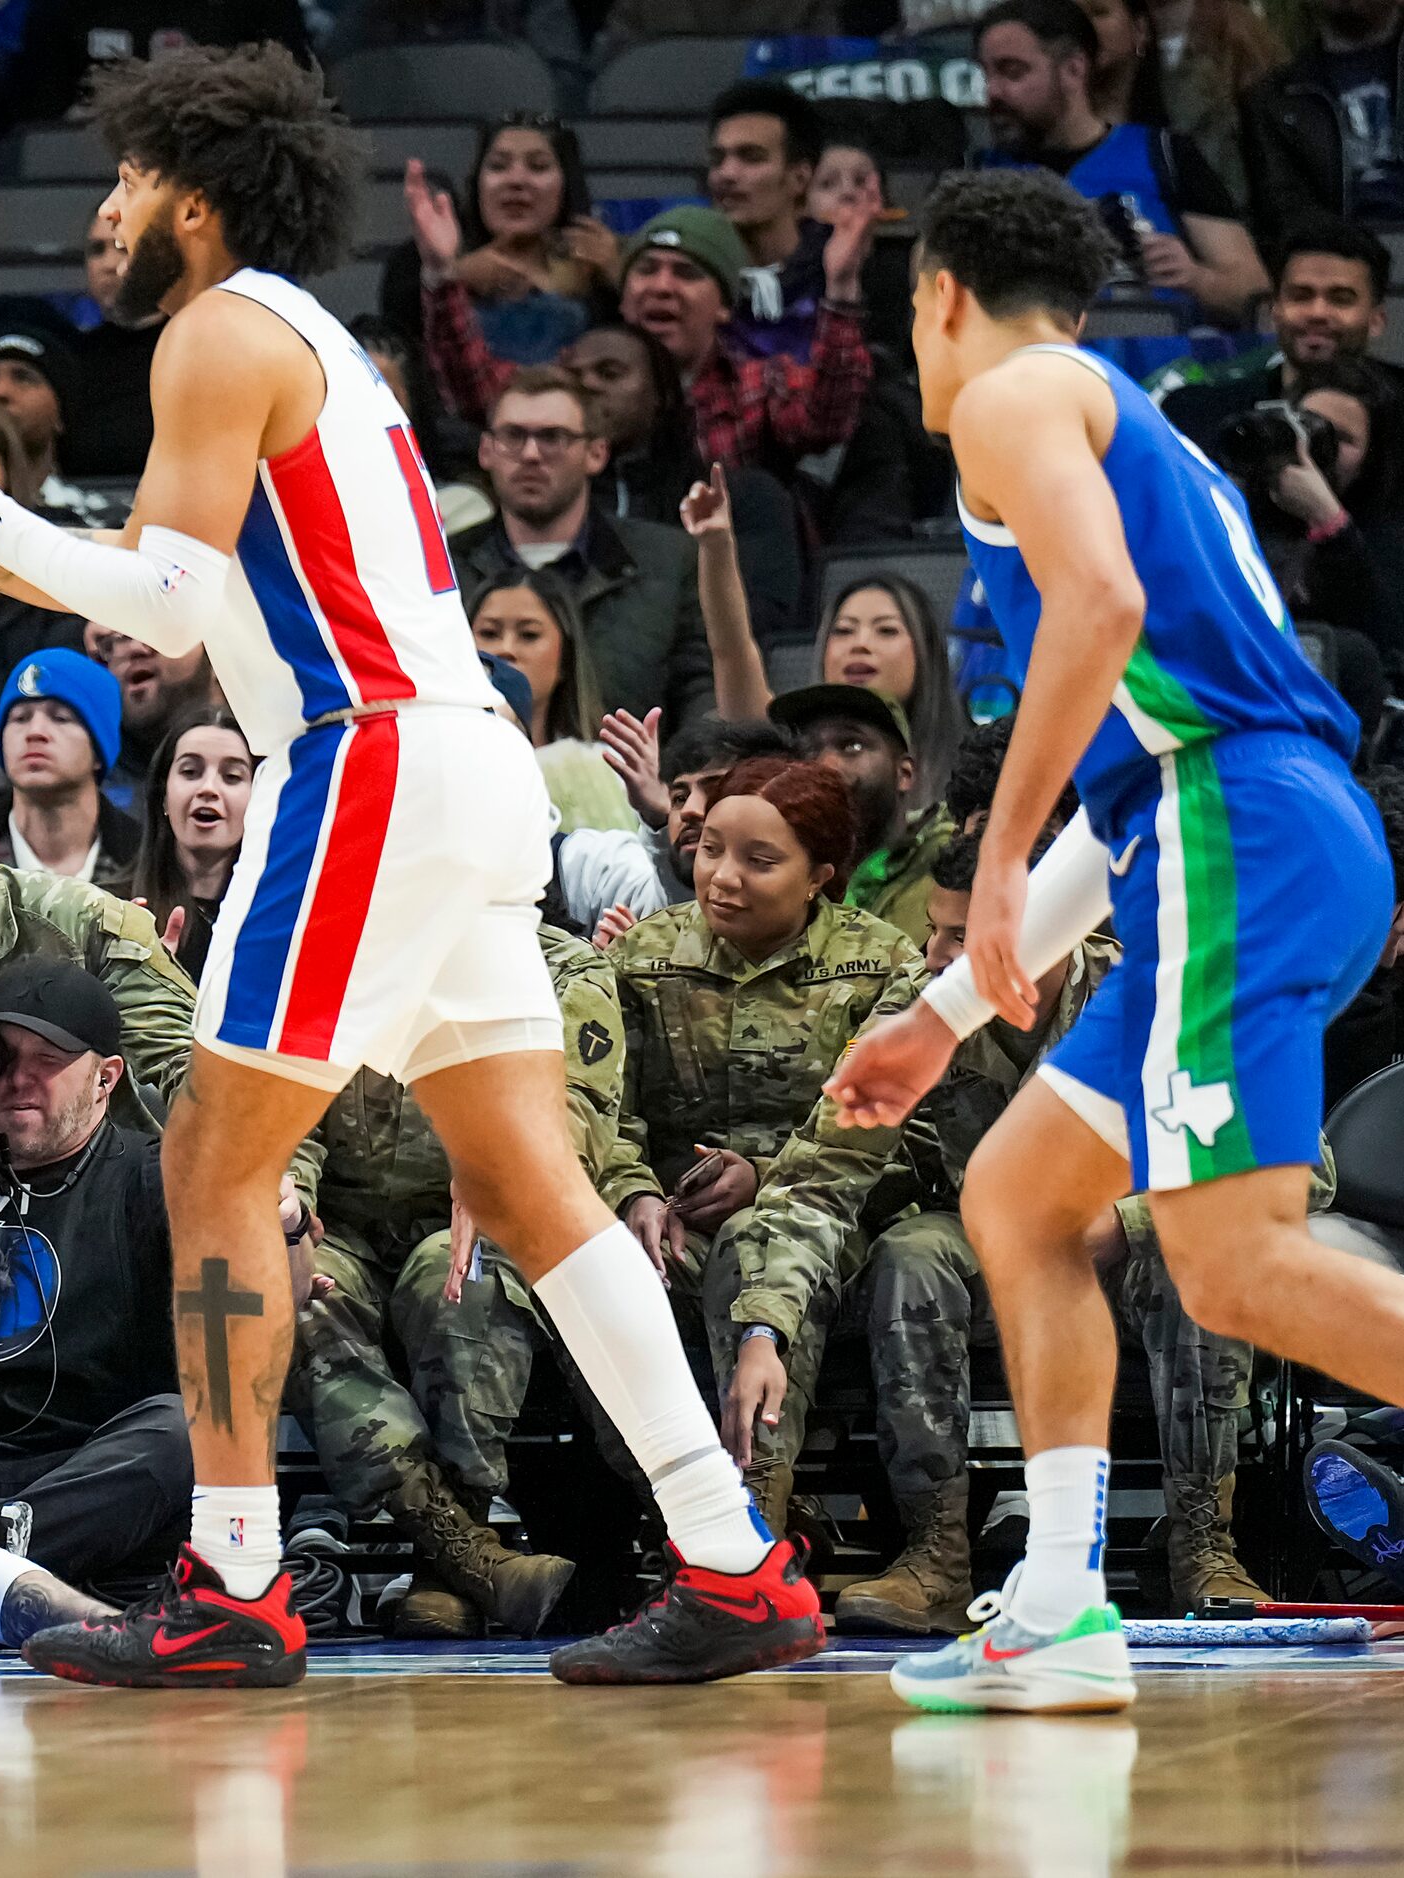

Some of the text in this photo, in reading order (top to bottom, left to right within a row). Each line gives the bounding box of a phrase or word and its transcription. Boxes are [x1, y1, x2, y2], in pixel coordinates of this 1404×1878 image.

[385, 423, 458, 595] 1
[650, 959, 679, 972] LEW
[834, 958, 882, 976] ARMY
